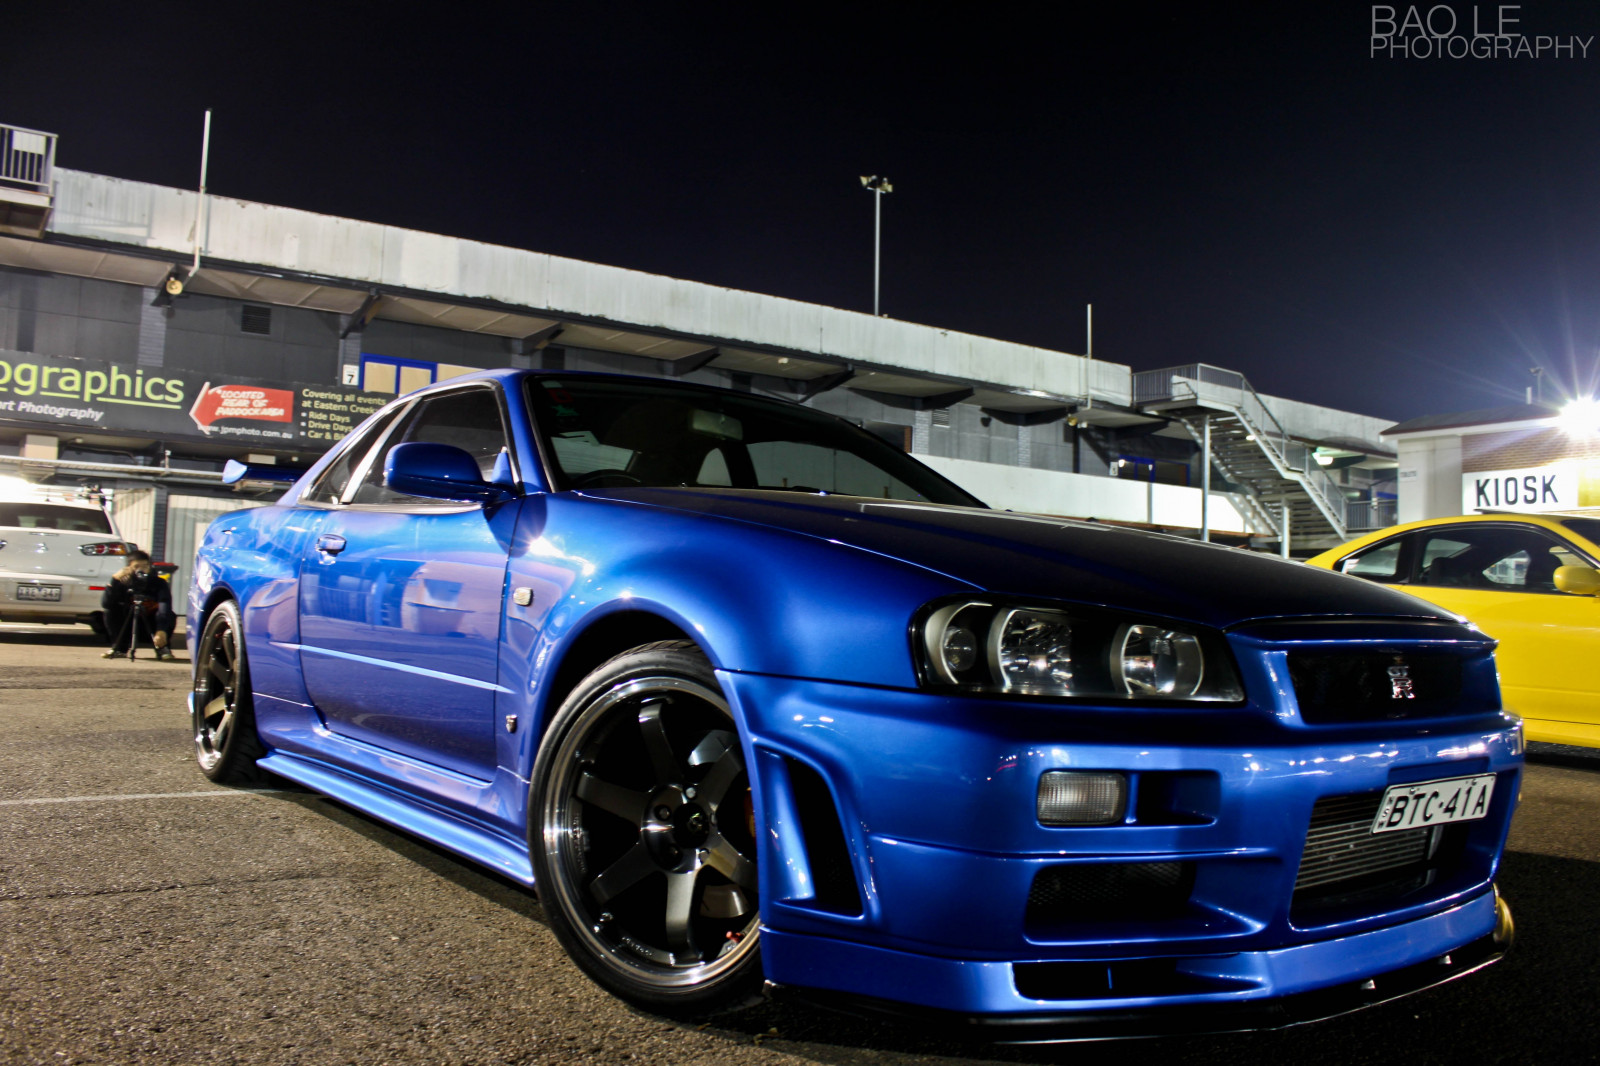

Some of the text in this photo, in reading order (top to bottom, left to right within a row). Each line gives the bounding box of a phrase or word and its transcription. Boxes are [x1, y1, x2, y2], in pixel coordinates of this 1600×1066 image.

[347, 373, 354, 384] 7
[220, 390, 266, 400] LOCATED
[302, 388, 387, 406] Covering all events
[221, 398, 269, 408] REAR OF
[301, 400, 312, 408] at
[313, 400, 348, 412] Eastern
[0, 400, 104, 422] rt Photography
[308, 411, 350, 424] Ride Days
[308, 420, 353, 433] Drive Days
[307, 430, 323, 439] Car
[324, 431, 332, 440] &
[1475, 475, 1558, 507] KIOSK
